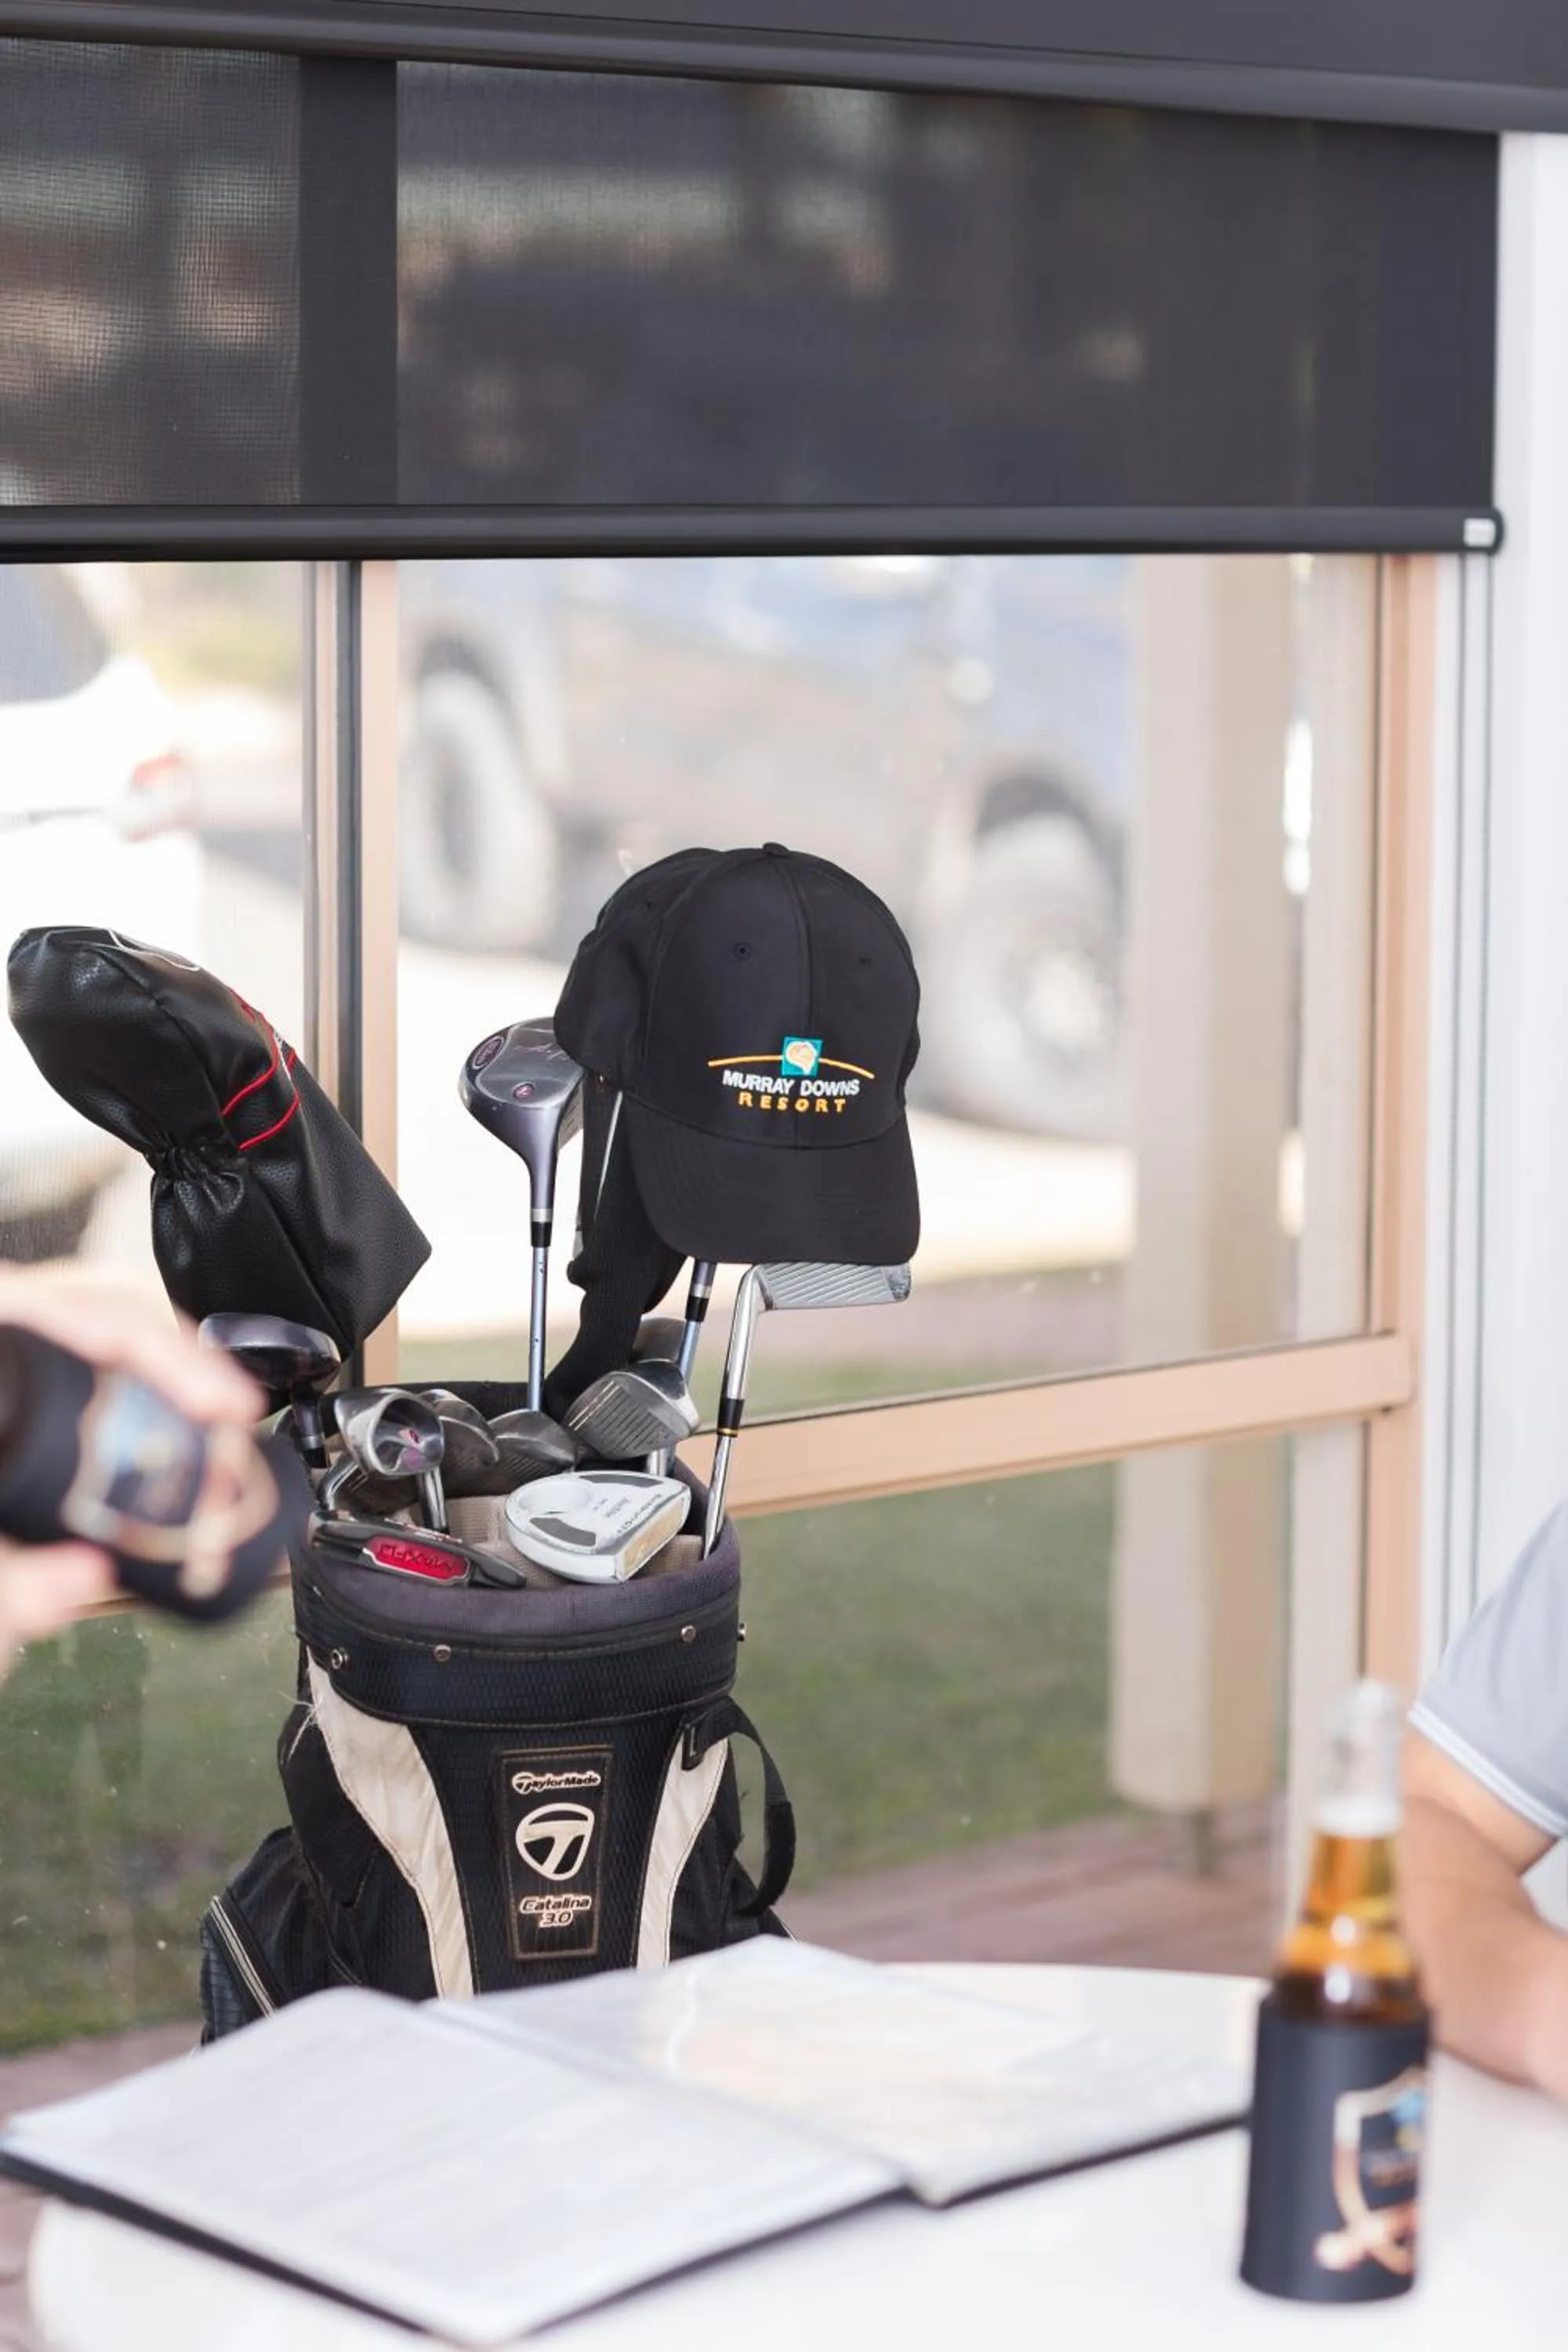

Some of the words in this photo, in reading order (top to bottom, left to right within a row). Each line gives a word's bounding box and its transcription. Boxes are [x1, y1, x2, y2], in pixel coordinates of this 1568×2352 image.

[722, 1069, 795, 1095] MURRAY
[800, 1079, 861, 1097] DOWNS
[738, 1091, 847, 1112] RESORT
[512, 1771, 601, 1795] TaylorMade
[519, 1893, 592, 1915] Catalina
[539, 1911, 574, 1928] 3.0
